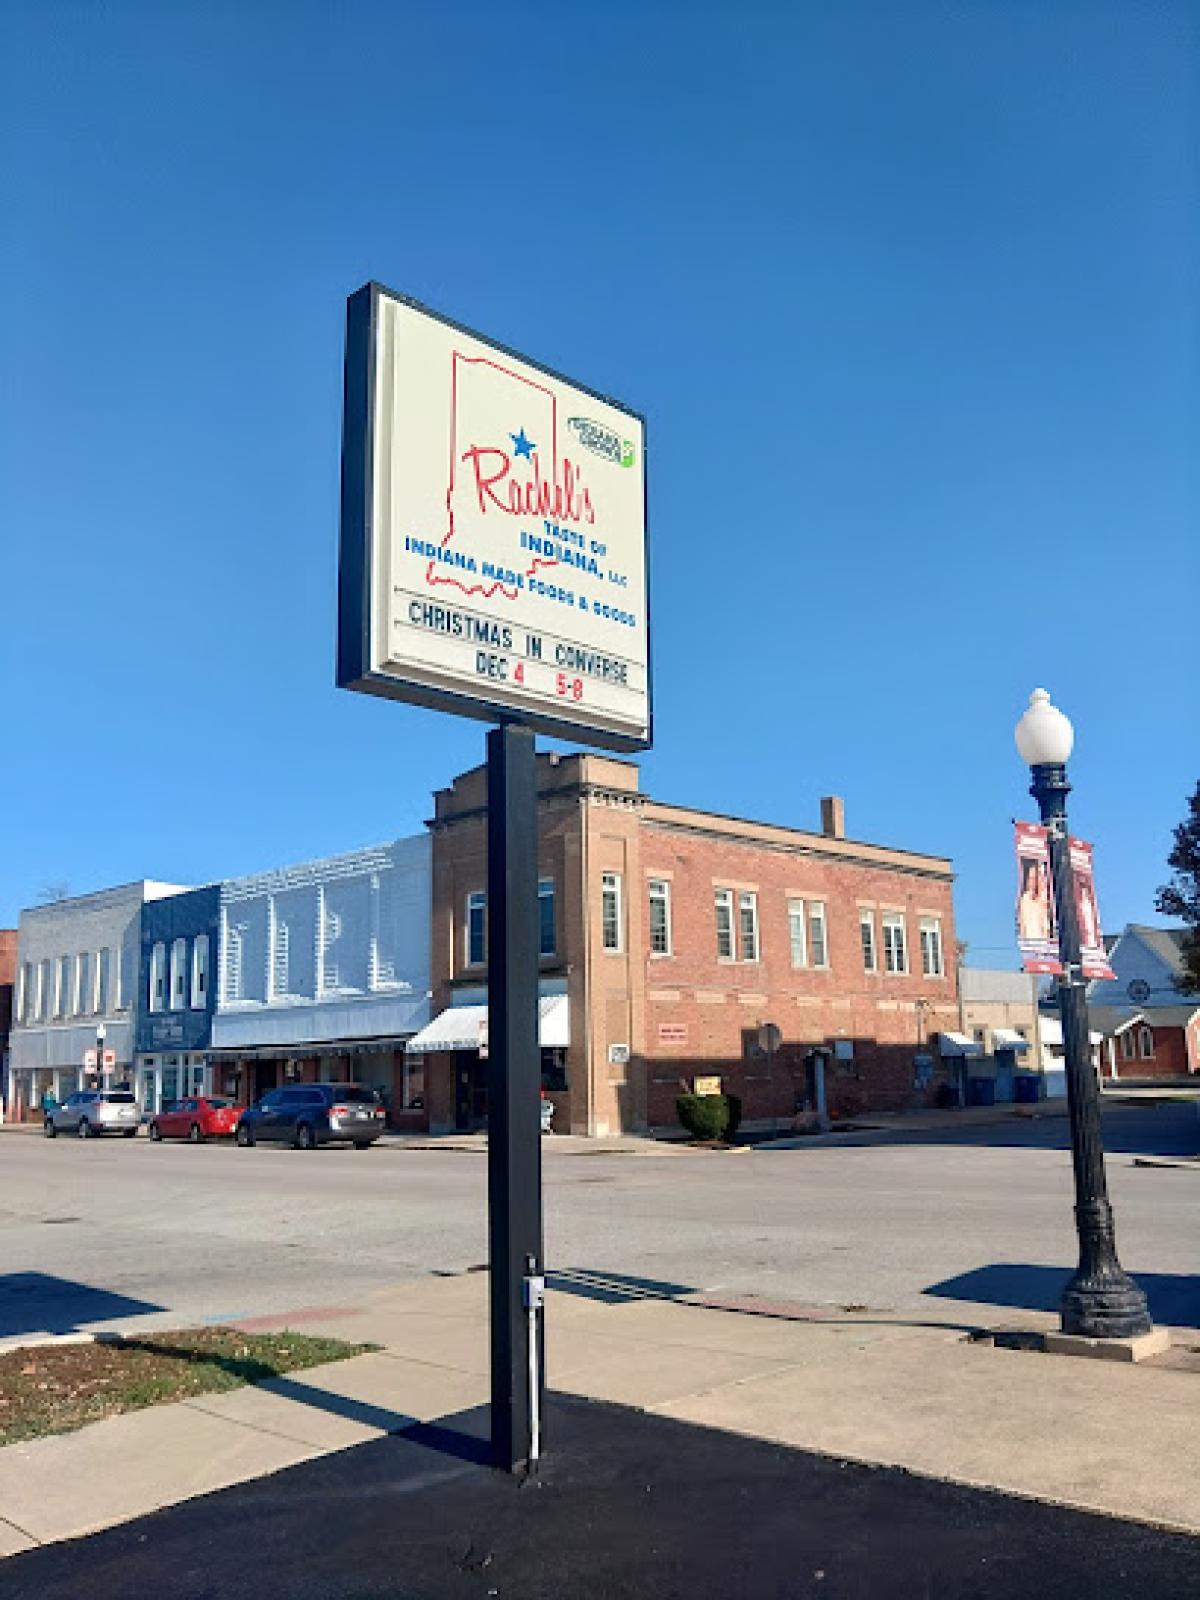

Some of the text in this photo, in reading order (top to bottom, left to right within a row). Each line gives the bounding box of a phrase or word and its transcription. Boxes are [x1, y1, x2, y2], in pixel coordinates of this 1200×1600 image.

[405, 536, 477, 573] INDIANA
[482, 561, 524, 588] MADE
[529, 579, 574, 606] FOODS
[409, 600, 628, 683] CHRISTMAS IN CONVERSE
[476, 650, 584, 701] DEC 4 5-8
